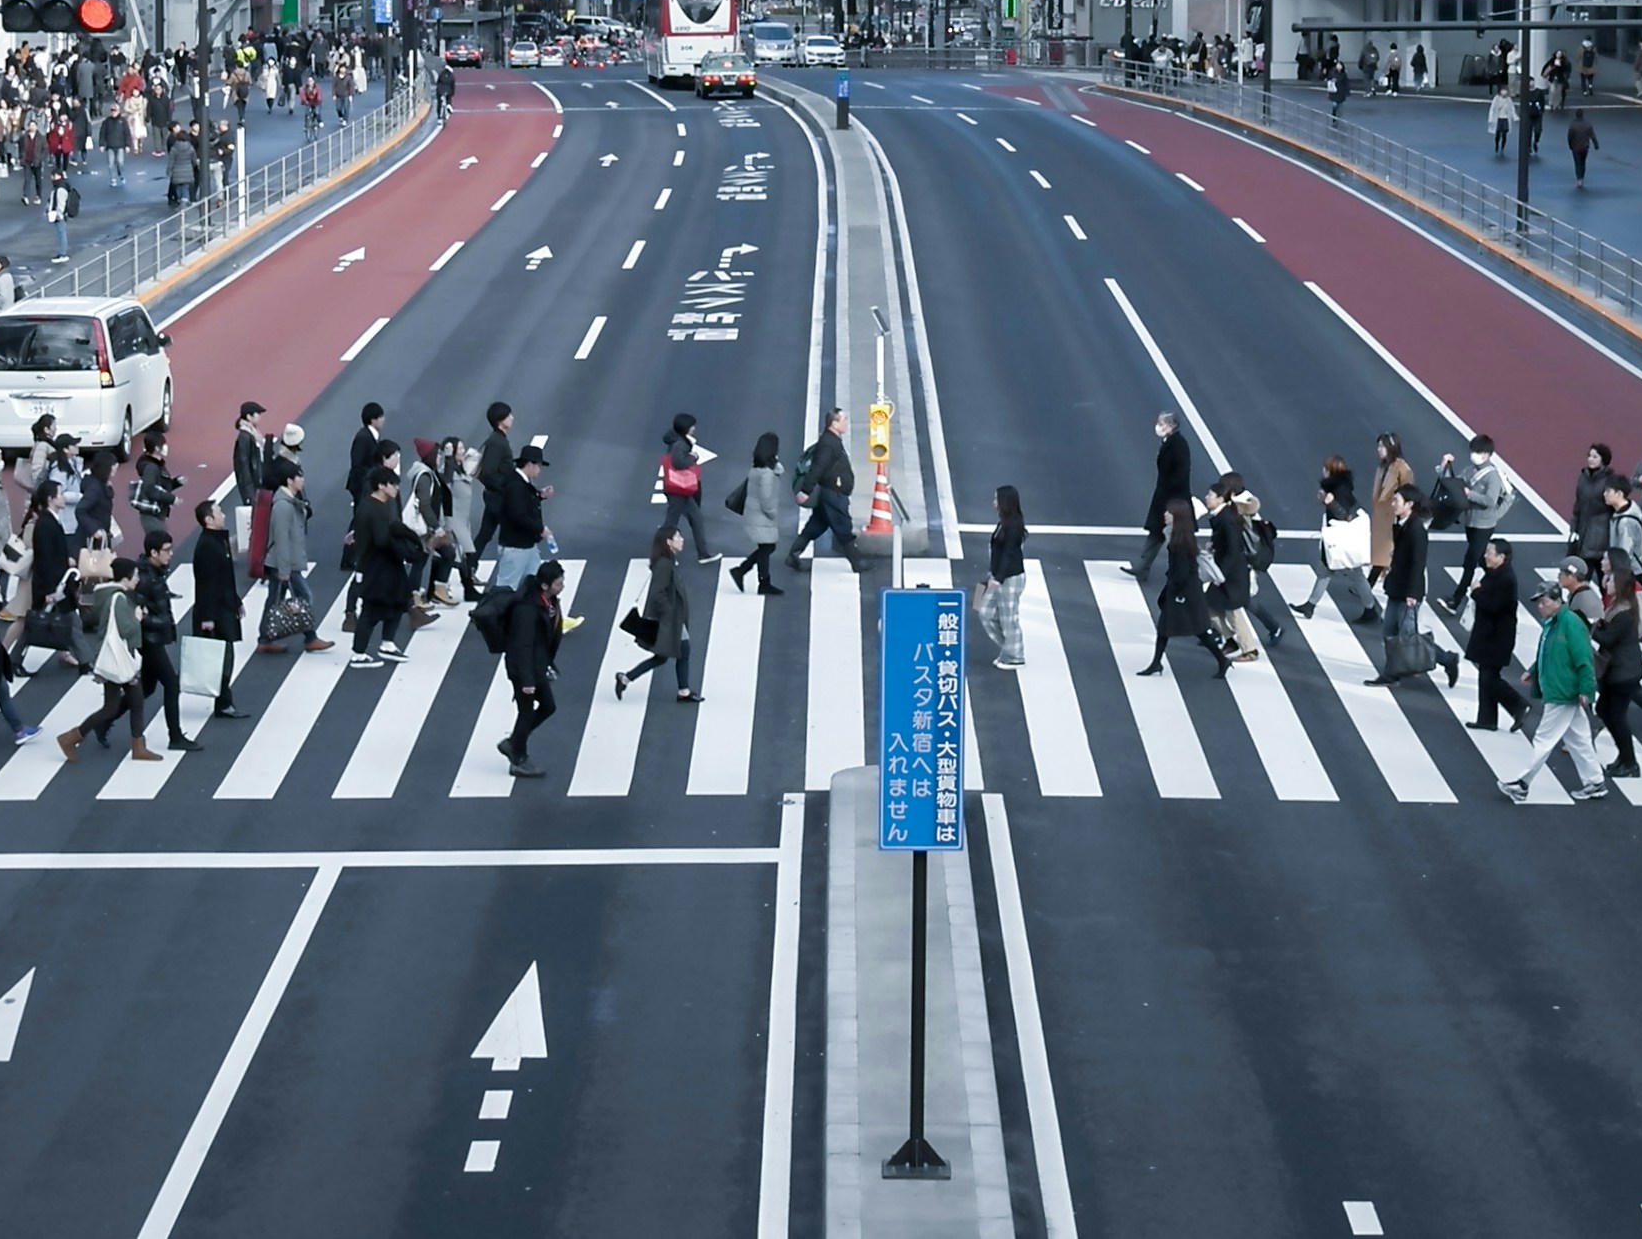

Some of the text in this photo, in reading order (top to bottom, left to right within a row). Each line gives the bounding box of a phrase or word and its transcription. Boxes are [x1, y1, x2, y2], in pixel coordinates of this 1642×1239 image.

[887, 732, 909, 843] 入れません
[912, 642, 934, 798] バスタ新宿へは
[936, 601, 959, 843] 一般車・貸切バス・大型貨物車は
